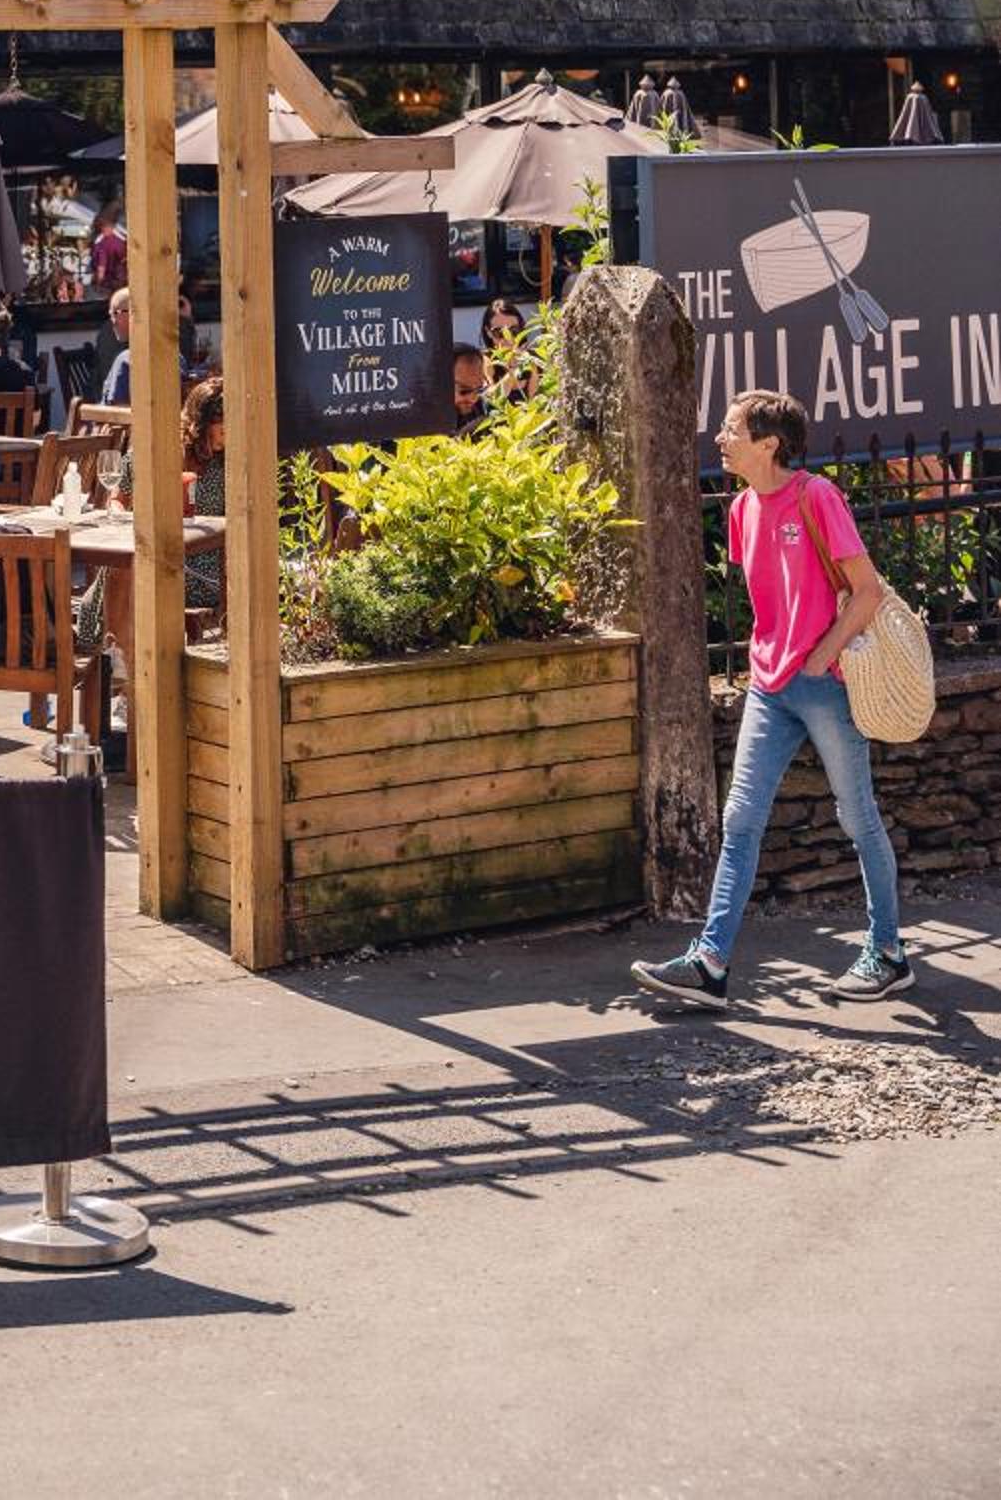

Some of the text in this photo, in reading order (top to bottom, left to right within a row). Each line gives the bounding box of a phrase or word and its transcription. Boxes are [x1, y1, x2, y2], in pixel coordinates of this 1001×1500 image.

[328, 235, 390, 263] A WARM
[310, 267, 410, 298] Welcome
[678, 269, 734, 320] THE
[343, 307, 382, 320] TO THE
[297, 317, 425, 353] VILLAGE INN
[348, 353, 382, 369] From
[332, 367, 399, 395] MILES
